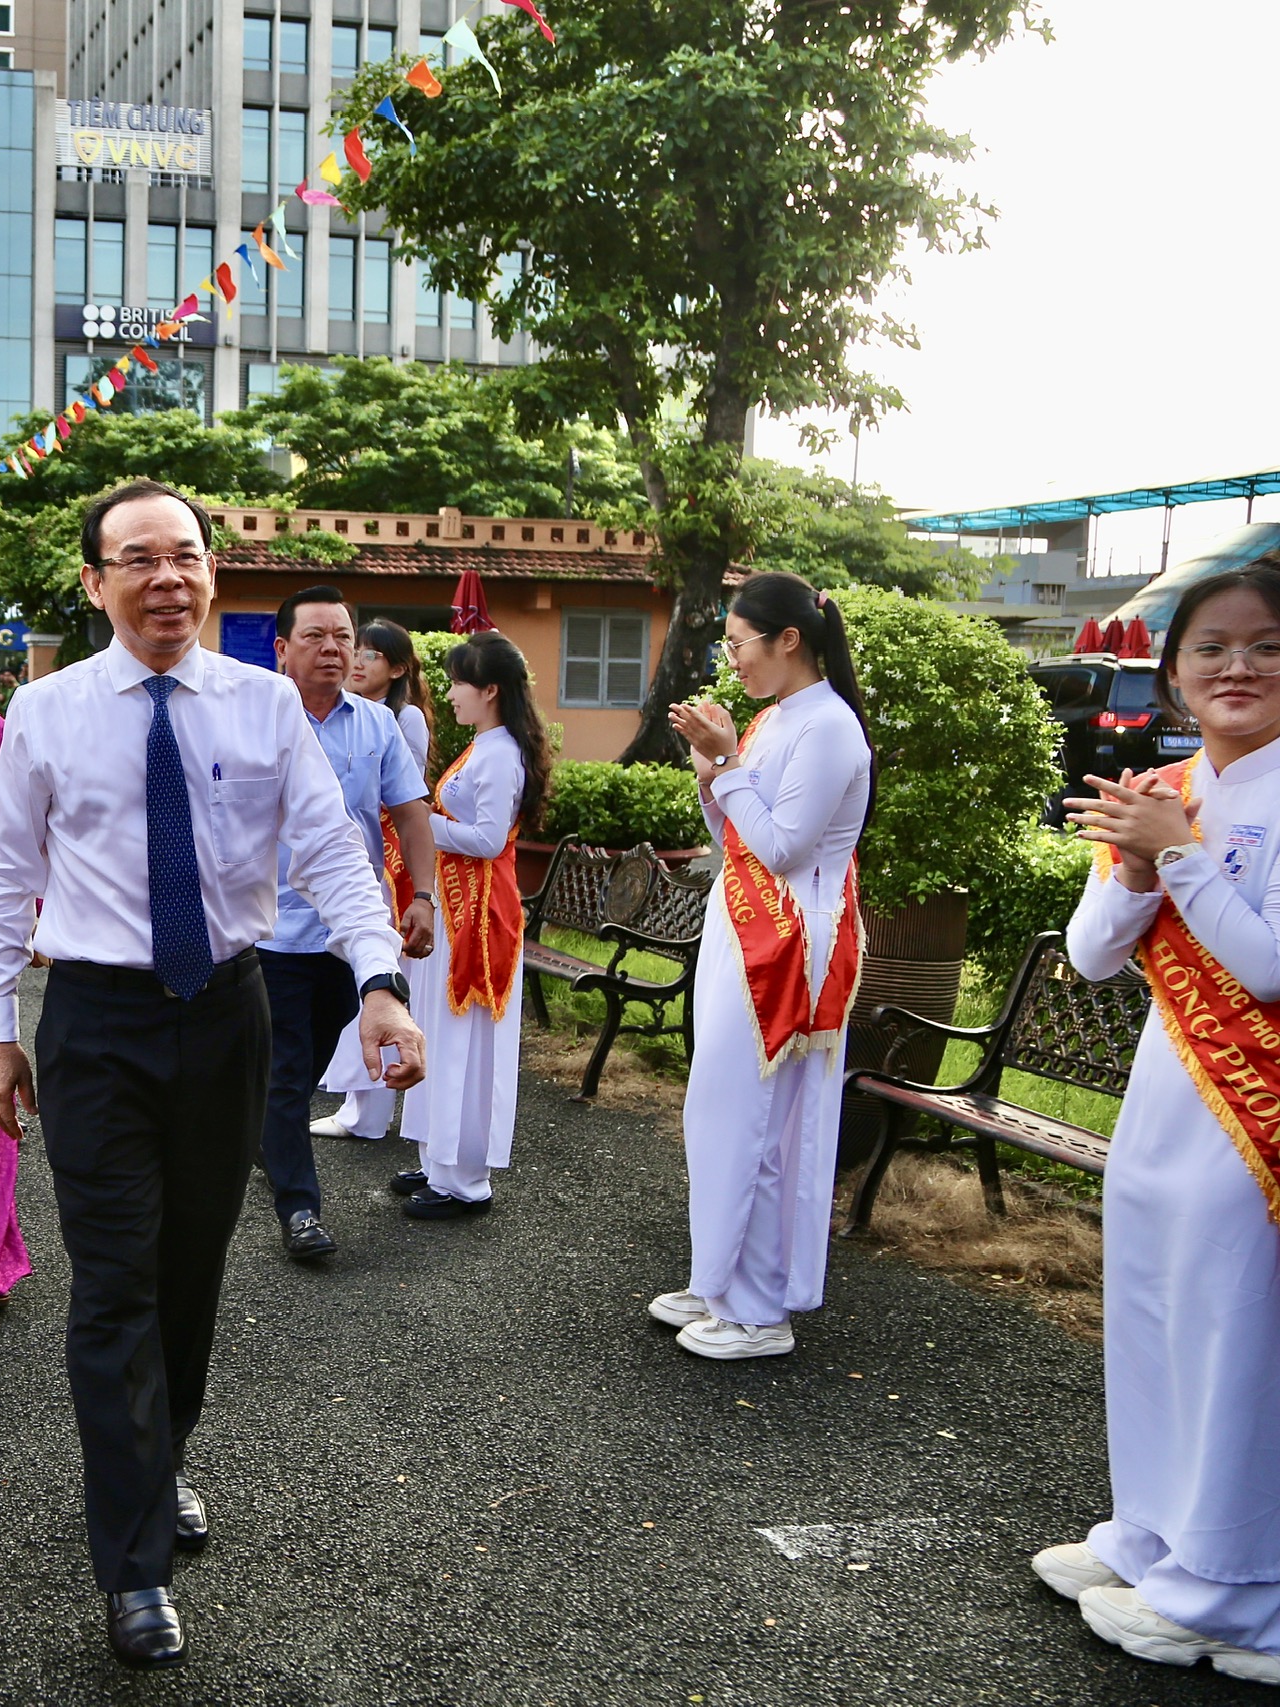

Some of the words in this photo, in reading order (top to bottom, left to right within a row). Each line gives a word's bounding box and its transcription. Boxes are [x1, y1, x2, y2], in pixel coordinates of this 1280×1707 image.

[106, 137, 198, 171] VNVC
[120, 306, 189, 326] BRITIS
[443, 860, 466, 930] PHONG
[760, 888, 792, 939] CHUYÊN
[1152, 937, 1225, 1040] HỒNG
[1211, 967, 1251, 1010] HỌC
